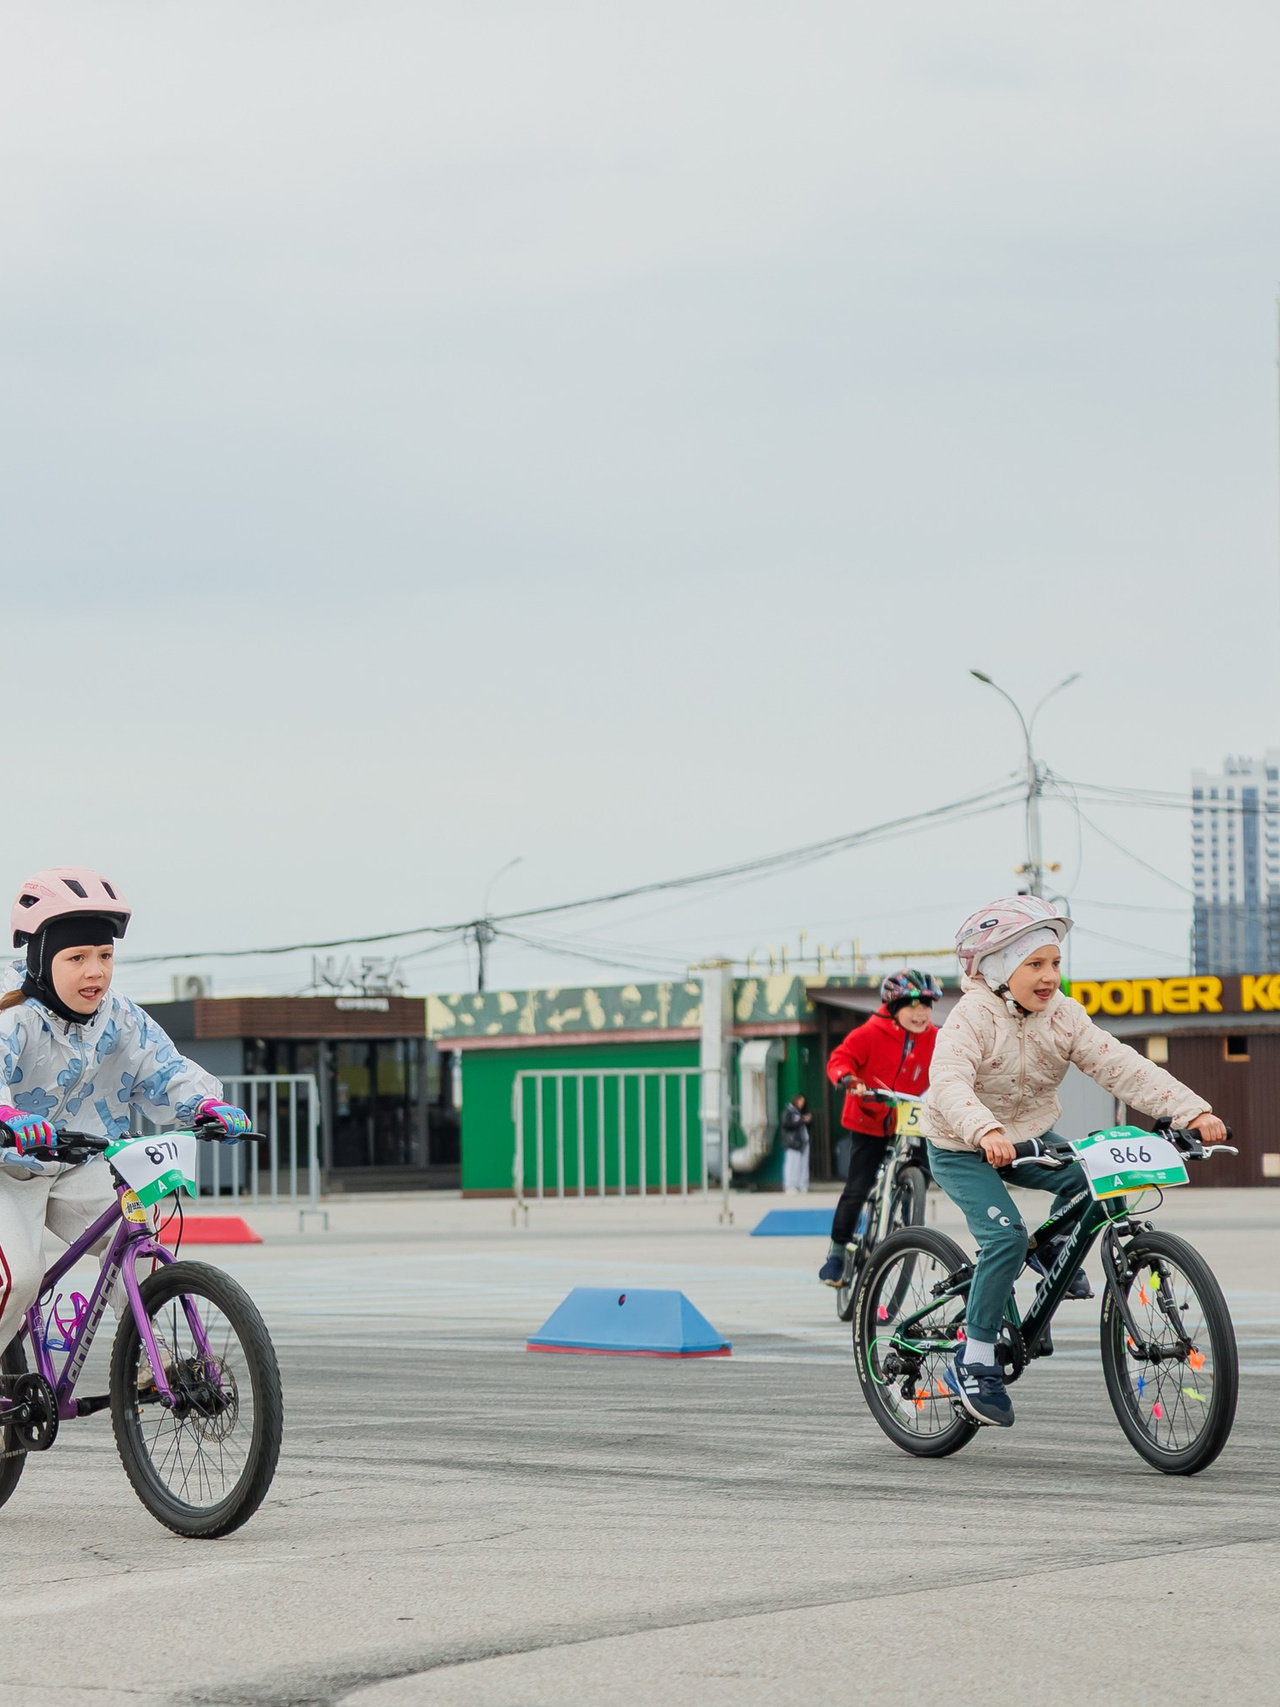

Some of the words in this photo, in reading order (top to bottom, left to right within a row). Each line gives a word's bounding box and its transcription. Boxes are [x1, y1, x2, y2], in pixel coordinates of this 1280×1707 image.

[1071, 976, 1223, 1015] DONER
[1110, 1145, 1152, 1163] 866
[157, 1179, 167, 1193] A
[1113, 1175, 1124, 1187] A
